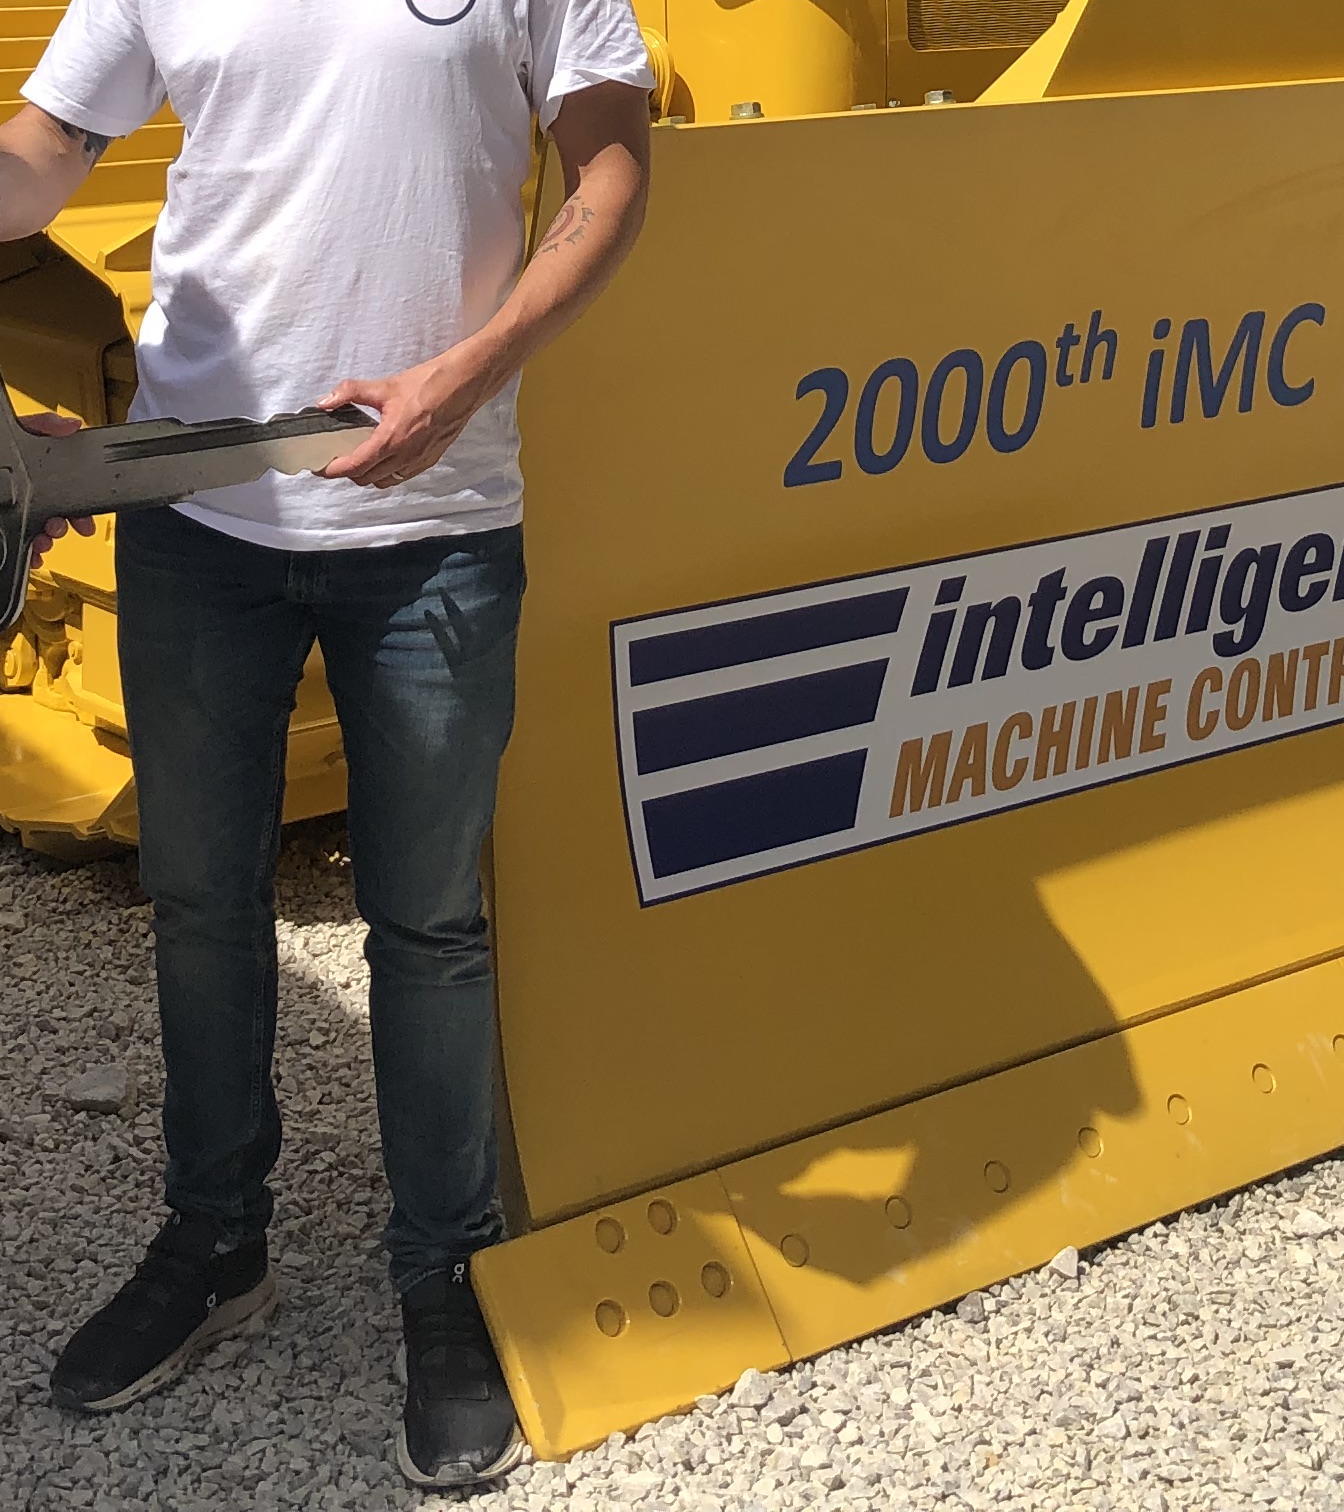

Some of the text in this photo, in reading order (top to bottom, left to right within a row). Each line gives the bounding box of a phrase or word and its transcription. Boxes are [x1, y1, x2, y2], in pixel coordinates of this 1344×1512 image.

[783, 309, 1119, 488] 2000th
[1140, 302, 1326, 430] iMC
[888, 678, 1170, 820] MACHINE
